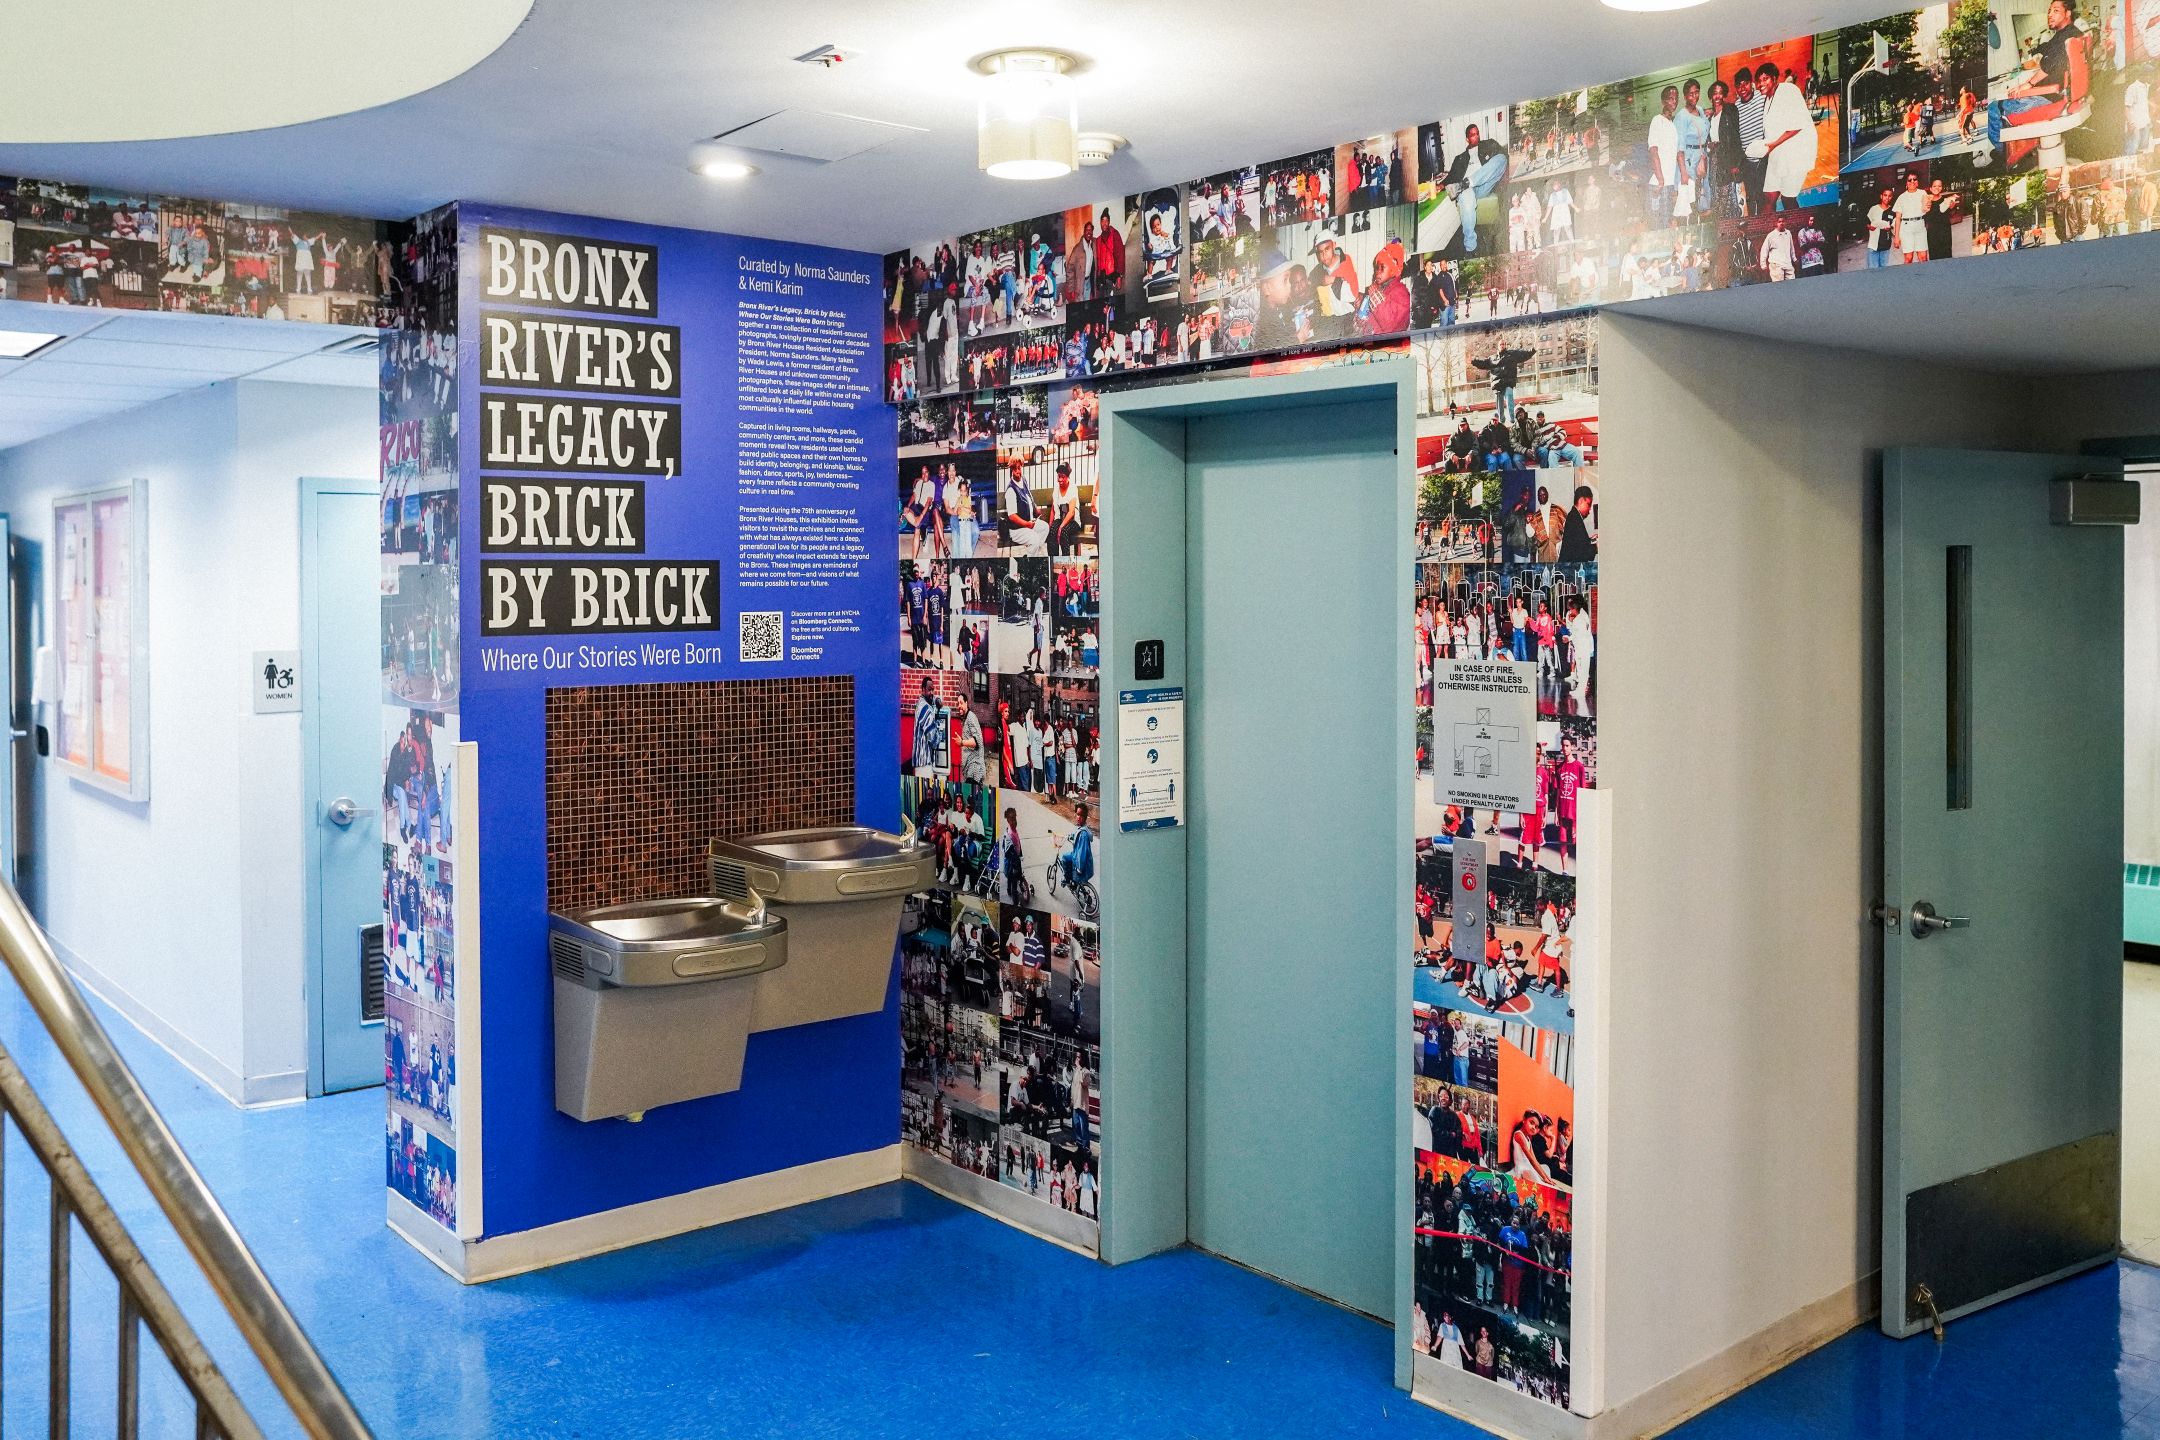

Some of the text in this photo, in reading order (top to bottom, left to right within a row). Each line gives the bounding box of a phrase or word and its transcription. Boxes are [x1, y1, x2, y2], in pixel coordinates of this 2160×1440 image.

[486, 234, 650, 310] BRONX
[738, 256, 870, 284] Curated by Norma Saunders
[738, 276, 803, 296] & Kemi Karim
[739, 301, 757, 309] Bronx
[757, 303, 779, 311] River's
[820, 309, 828, 317] by
[828, 310, 846, 318] Brick:
[739, 310, 759, 318] Where
[772, 313, 794, 322] Stories
[826, 319, 845, 328] brings
[739, 338, 746, 346] by
[765, 340, 781, 348] River
[782, 342, 804, 350] Houses
[805, 344, 831, 352] Resident
[831, 346, 865, 355] Association
[778, 333, 801, 342] lovingly
[802, 336, 831, 344] preserved
[845, 339, 870, 347] decades
[486, 318, 674, 391] RIVER'S
[769, 350, 790, 358] Norma
[821, 354, 837, 363] Many
[755, 367, 778, 375] Houses
[818, 373, 851, 383] community
[802, 380, 823, 389] images
[739, 404, 777, 412] communities
[754, 395, 782, 404] culturally
[783, 397, 811, 405] influential
[831, 400, 854, 410] housing
[739, 422, 766, 430] Captured
[774, 424, 790, 432] living
[487, 402, 675, 480] LEGACY,
[739, 432, 772, 440] community
[380, 420, 420, 483] RICO
[487, 484, 636, 547] BRICK
[770, 506, 790, 514] during
[815, 507, 848, 516] anniversary
[764, 579, 789, 587] possible
[488, 566, 712, 629] BY BRICK
[481, 642, 722, 672] Where Our Stories Were Born
[791, 646, 823, 654] Bloomberg
[1454, 664, 1461, 672] IN
[1497, 666, 1514, 675] FIRE,
[1466, 674, 1490, 682] STAIRS
[1493, 676, 1522, 684] UNLESS
[1438, 682, 1530, 694] OTHERWISE INSTRUCTED.
[1488, 794, 1520, 802] ELEVATORS
